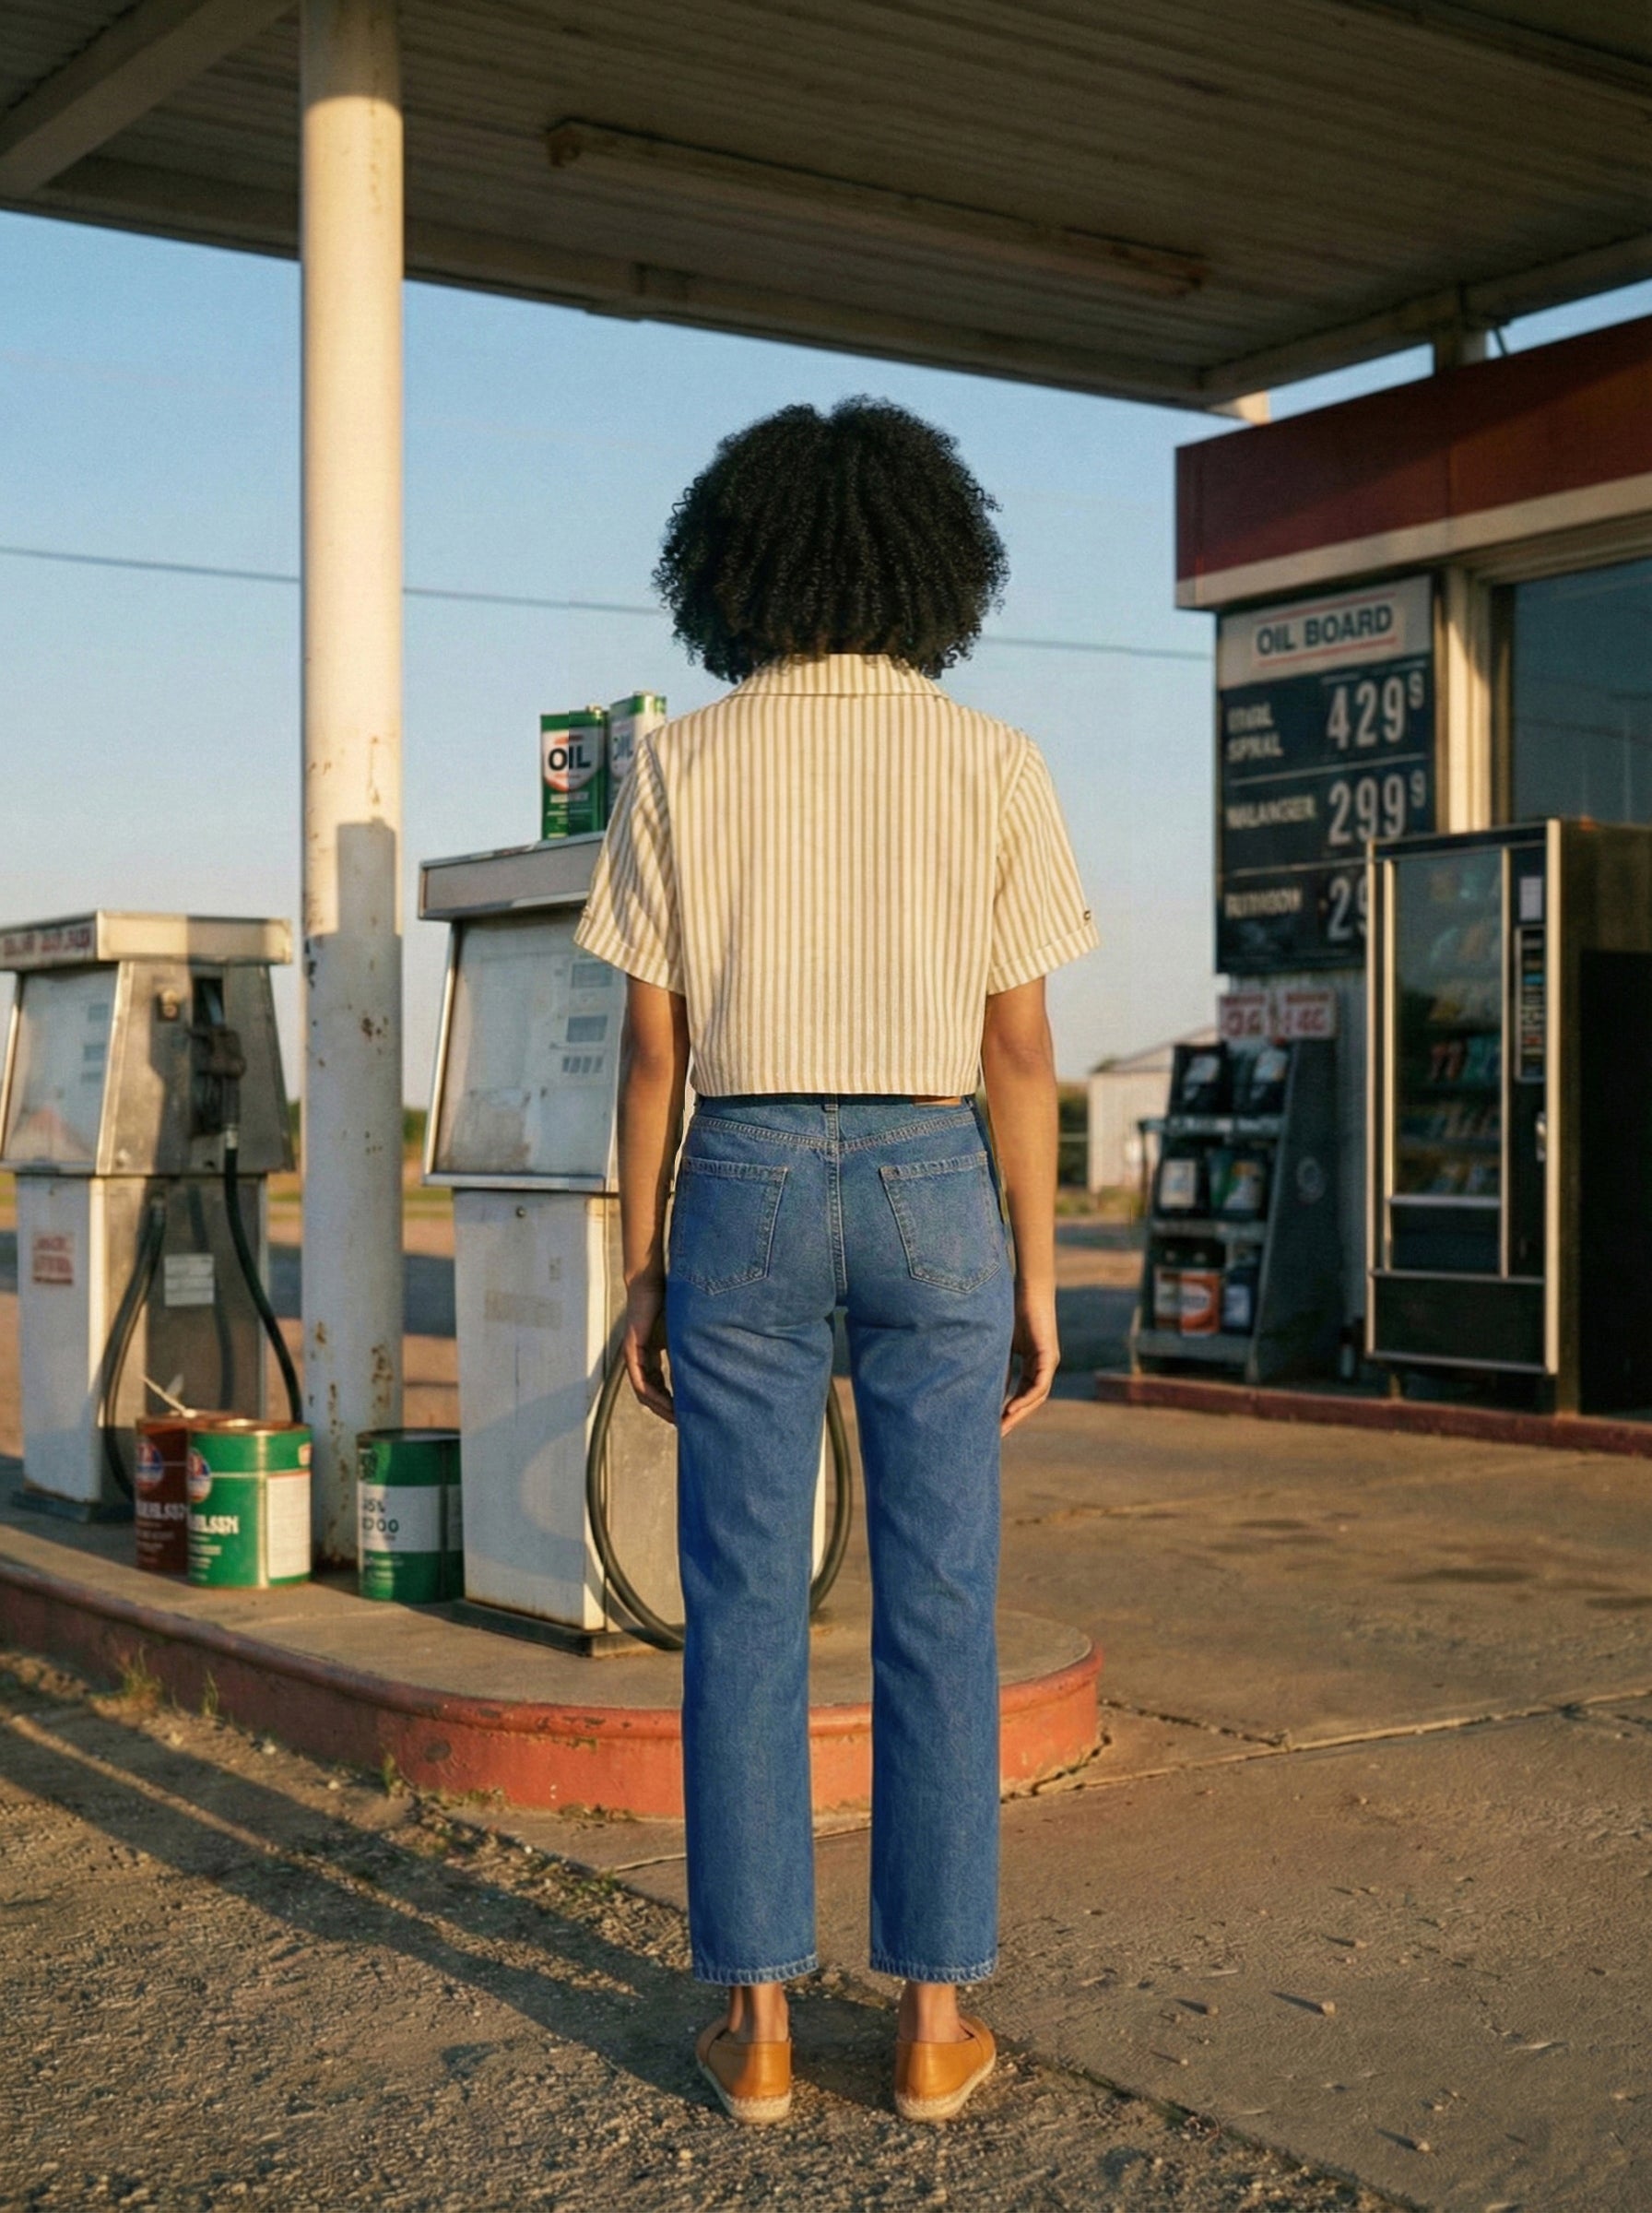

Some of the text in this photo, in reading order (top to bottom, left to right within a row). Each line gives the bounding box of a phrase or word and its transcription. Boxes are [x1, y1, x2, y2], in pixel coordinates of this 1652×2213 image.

[1257, 604, 1393, 655] OIL BOARD
[548, 744, 592, 771] OIL
